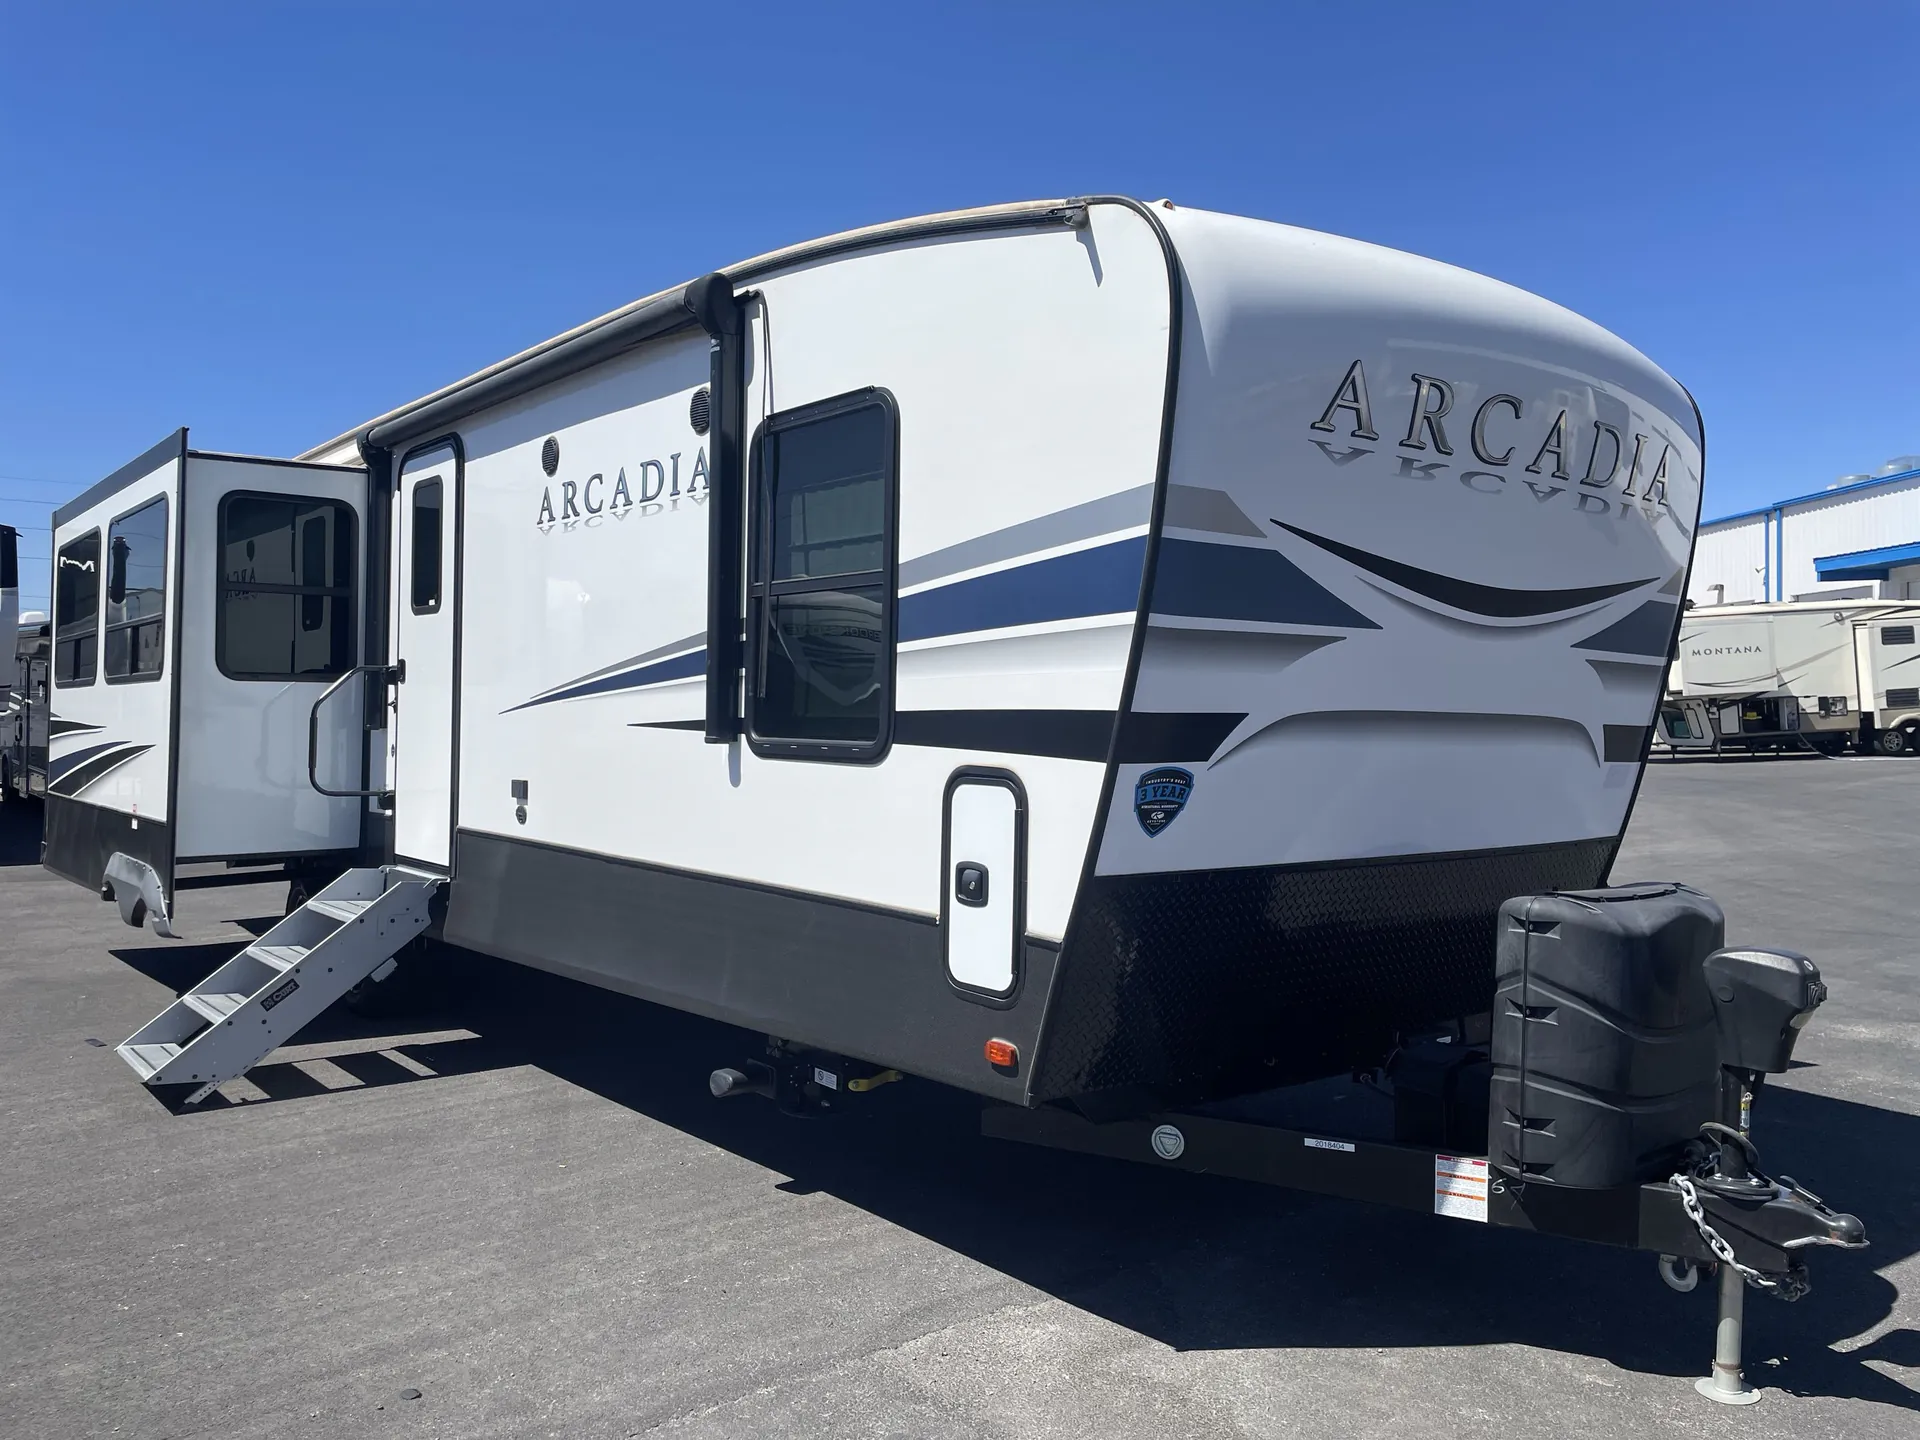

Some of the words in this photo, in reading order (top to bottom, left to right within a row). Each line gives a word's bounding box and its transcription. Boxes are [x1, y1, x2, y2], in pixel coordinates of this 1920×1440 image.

[1309, 359, 1670, 506] ARCADIA
[536, 446, 710, 525] ARCADIA
[1692, 646, 1762, 656] MONTANA
[1140, 788, 1148, 801] 3
[1152, 785, 1187, 800] YEAR
[1314, 1140, 1345, 1150] 2018404
